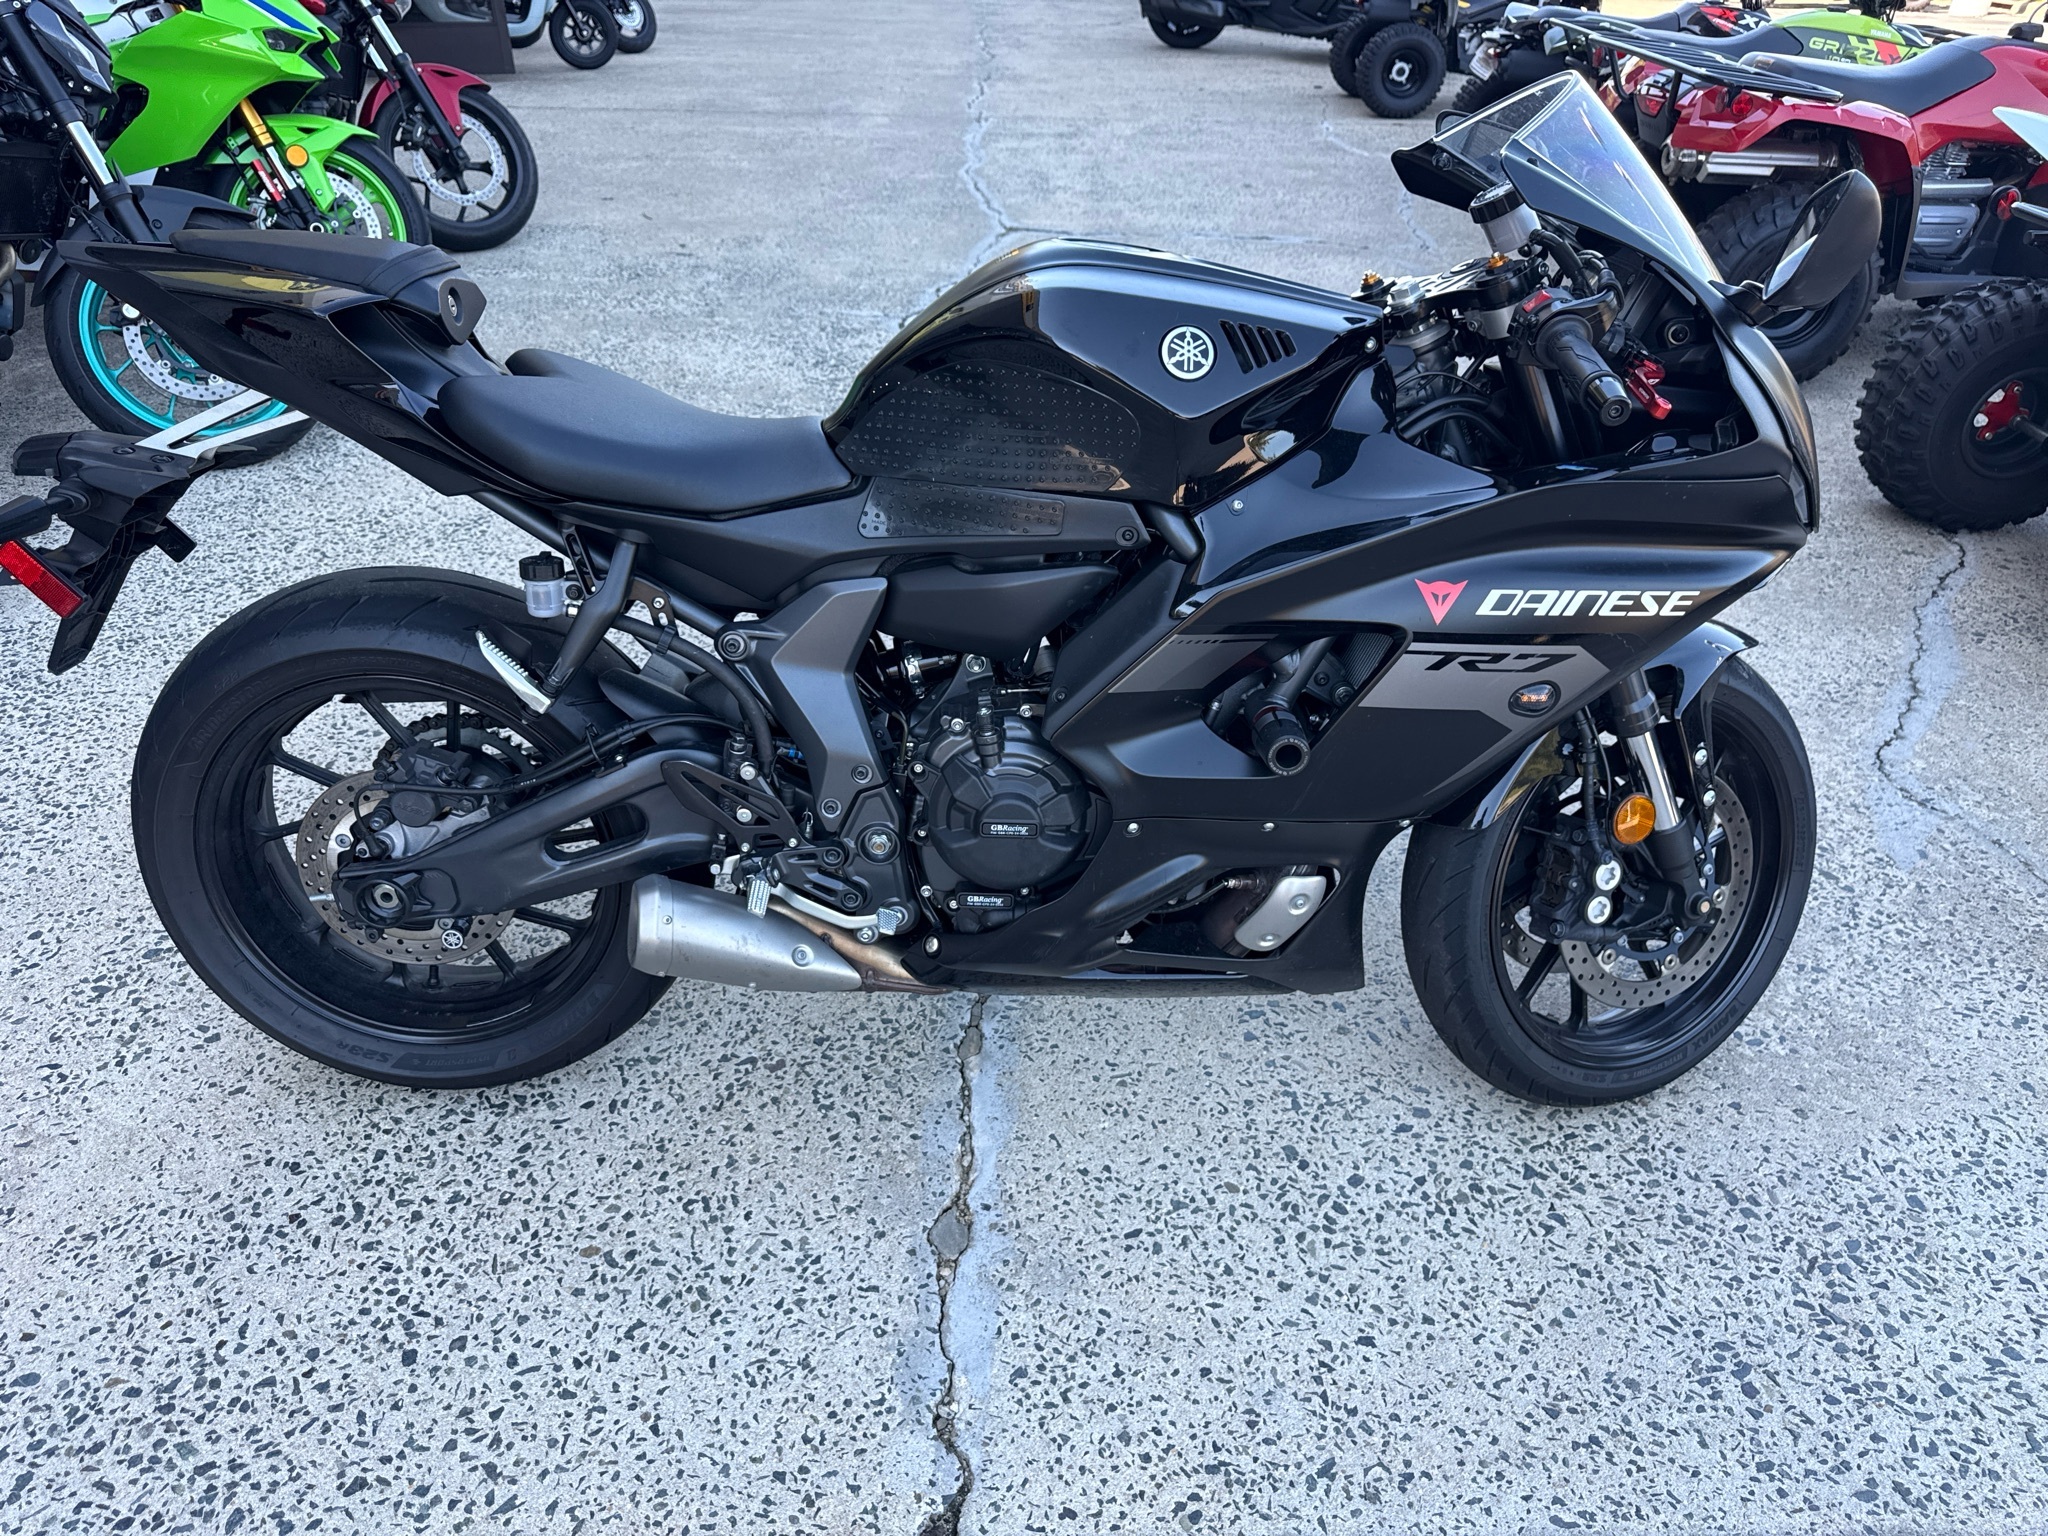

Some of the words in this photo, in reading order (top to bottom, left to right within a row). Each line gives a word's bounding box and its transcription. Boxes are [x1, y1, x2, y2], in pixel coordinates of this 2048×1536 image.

[1870, 29, 1892, 39] YAMAHA
[1808, 36, 1903, 65] GRIZZLY
[1475, 588, 1701, 617] DAINESE
[990, 824, 1029, 833] GBRacing
[967, 895, 1004, 904] GBRacing
